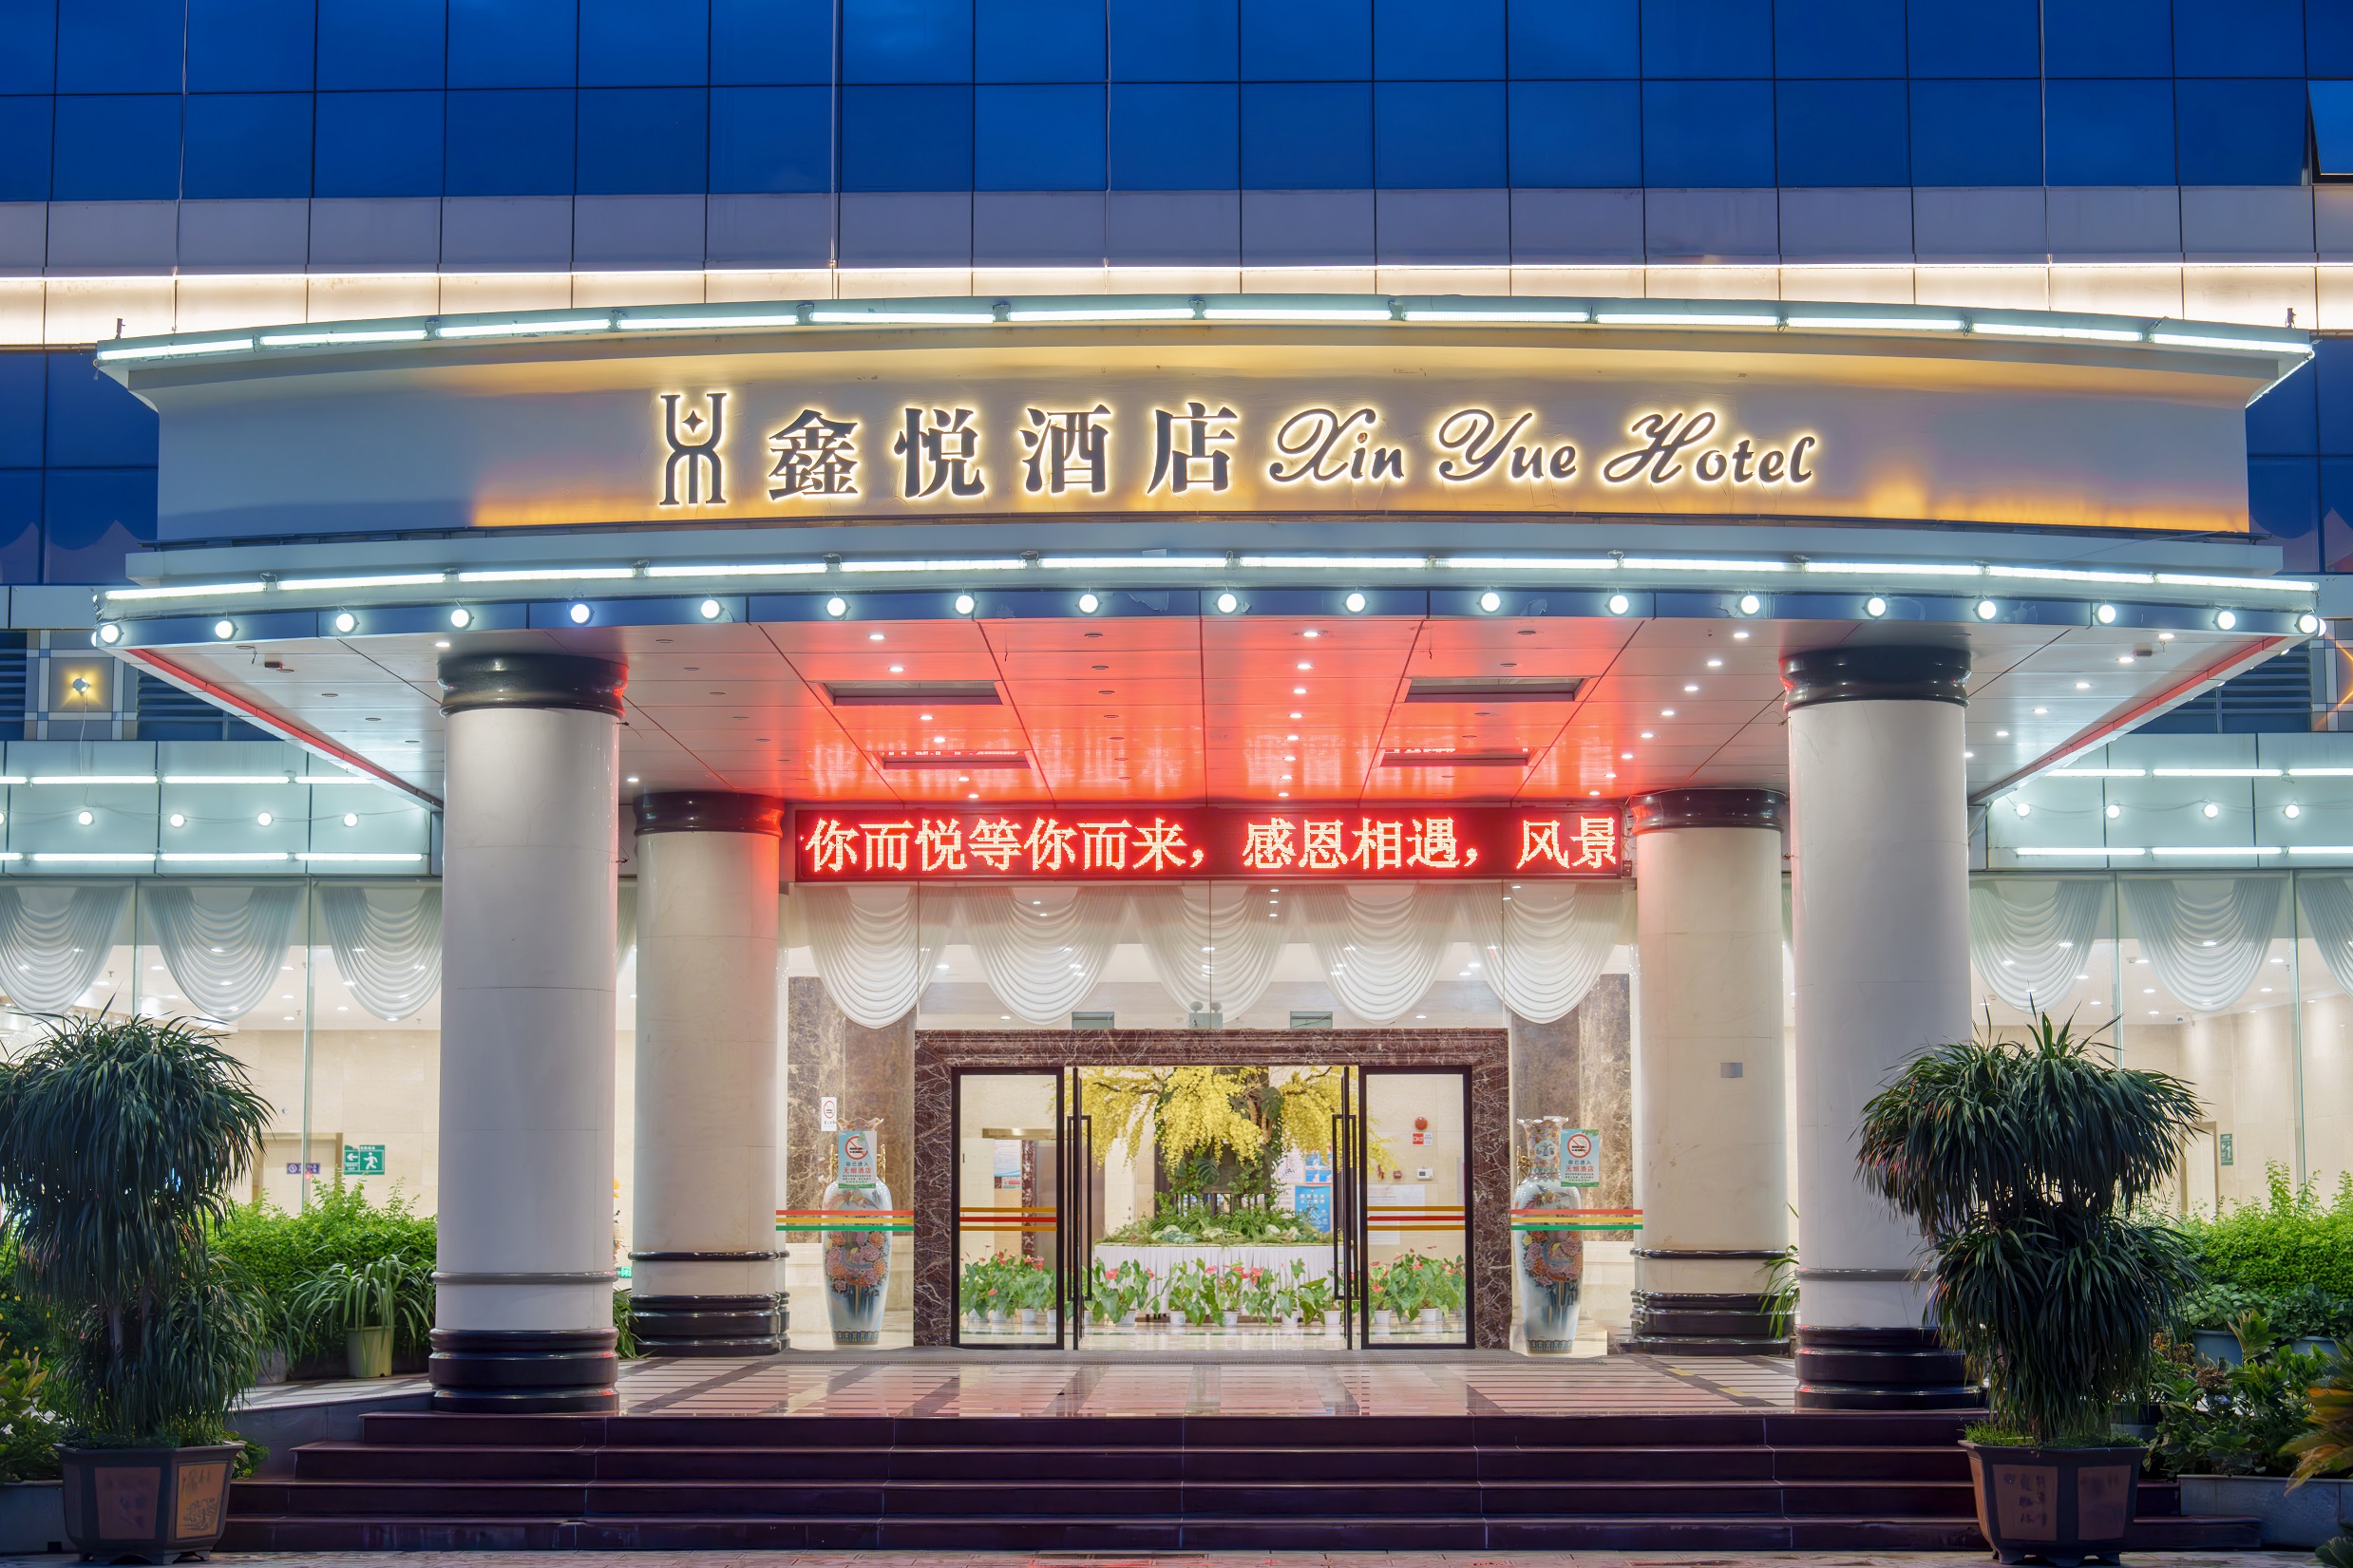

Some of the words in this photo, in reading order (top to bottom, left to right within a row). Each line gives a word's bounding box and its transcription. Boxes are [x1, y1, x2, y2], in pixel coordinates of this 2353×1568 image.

[767, 402, 1240, 501] 鑫悦酒店
[1268, 407, 1405, 482] Xin
[1437, 408, 1578, 482] Yue
[1603, 410, 1816, 483] Hotel
